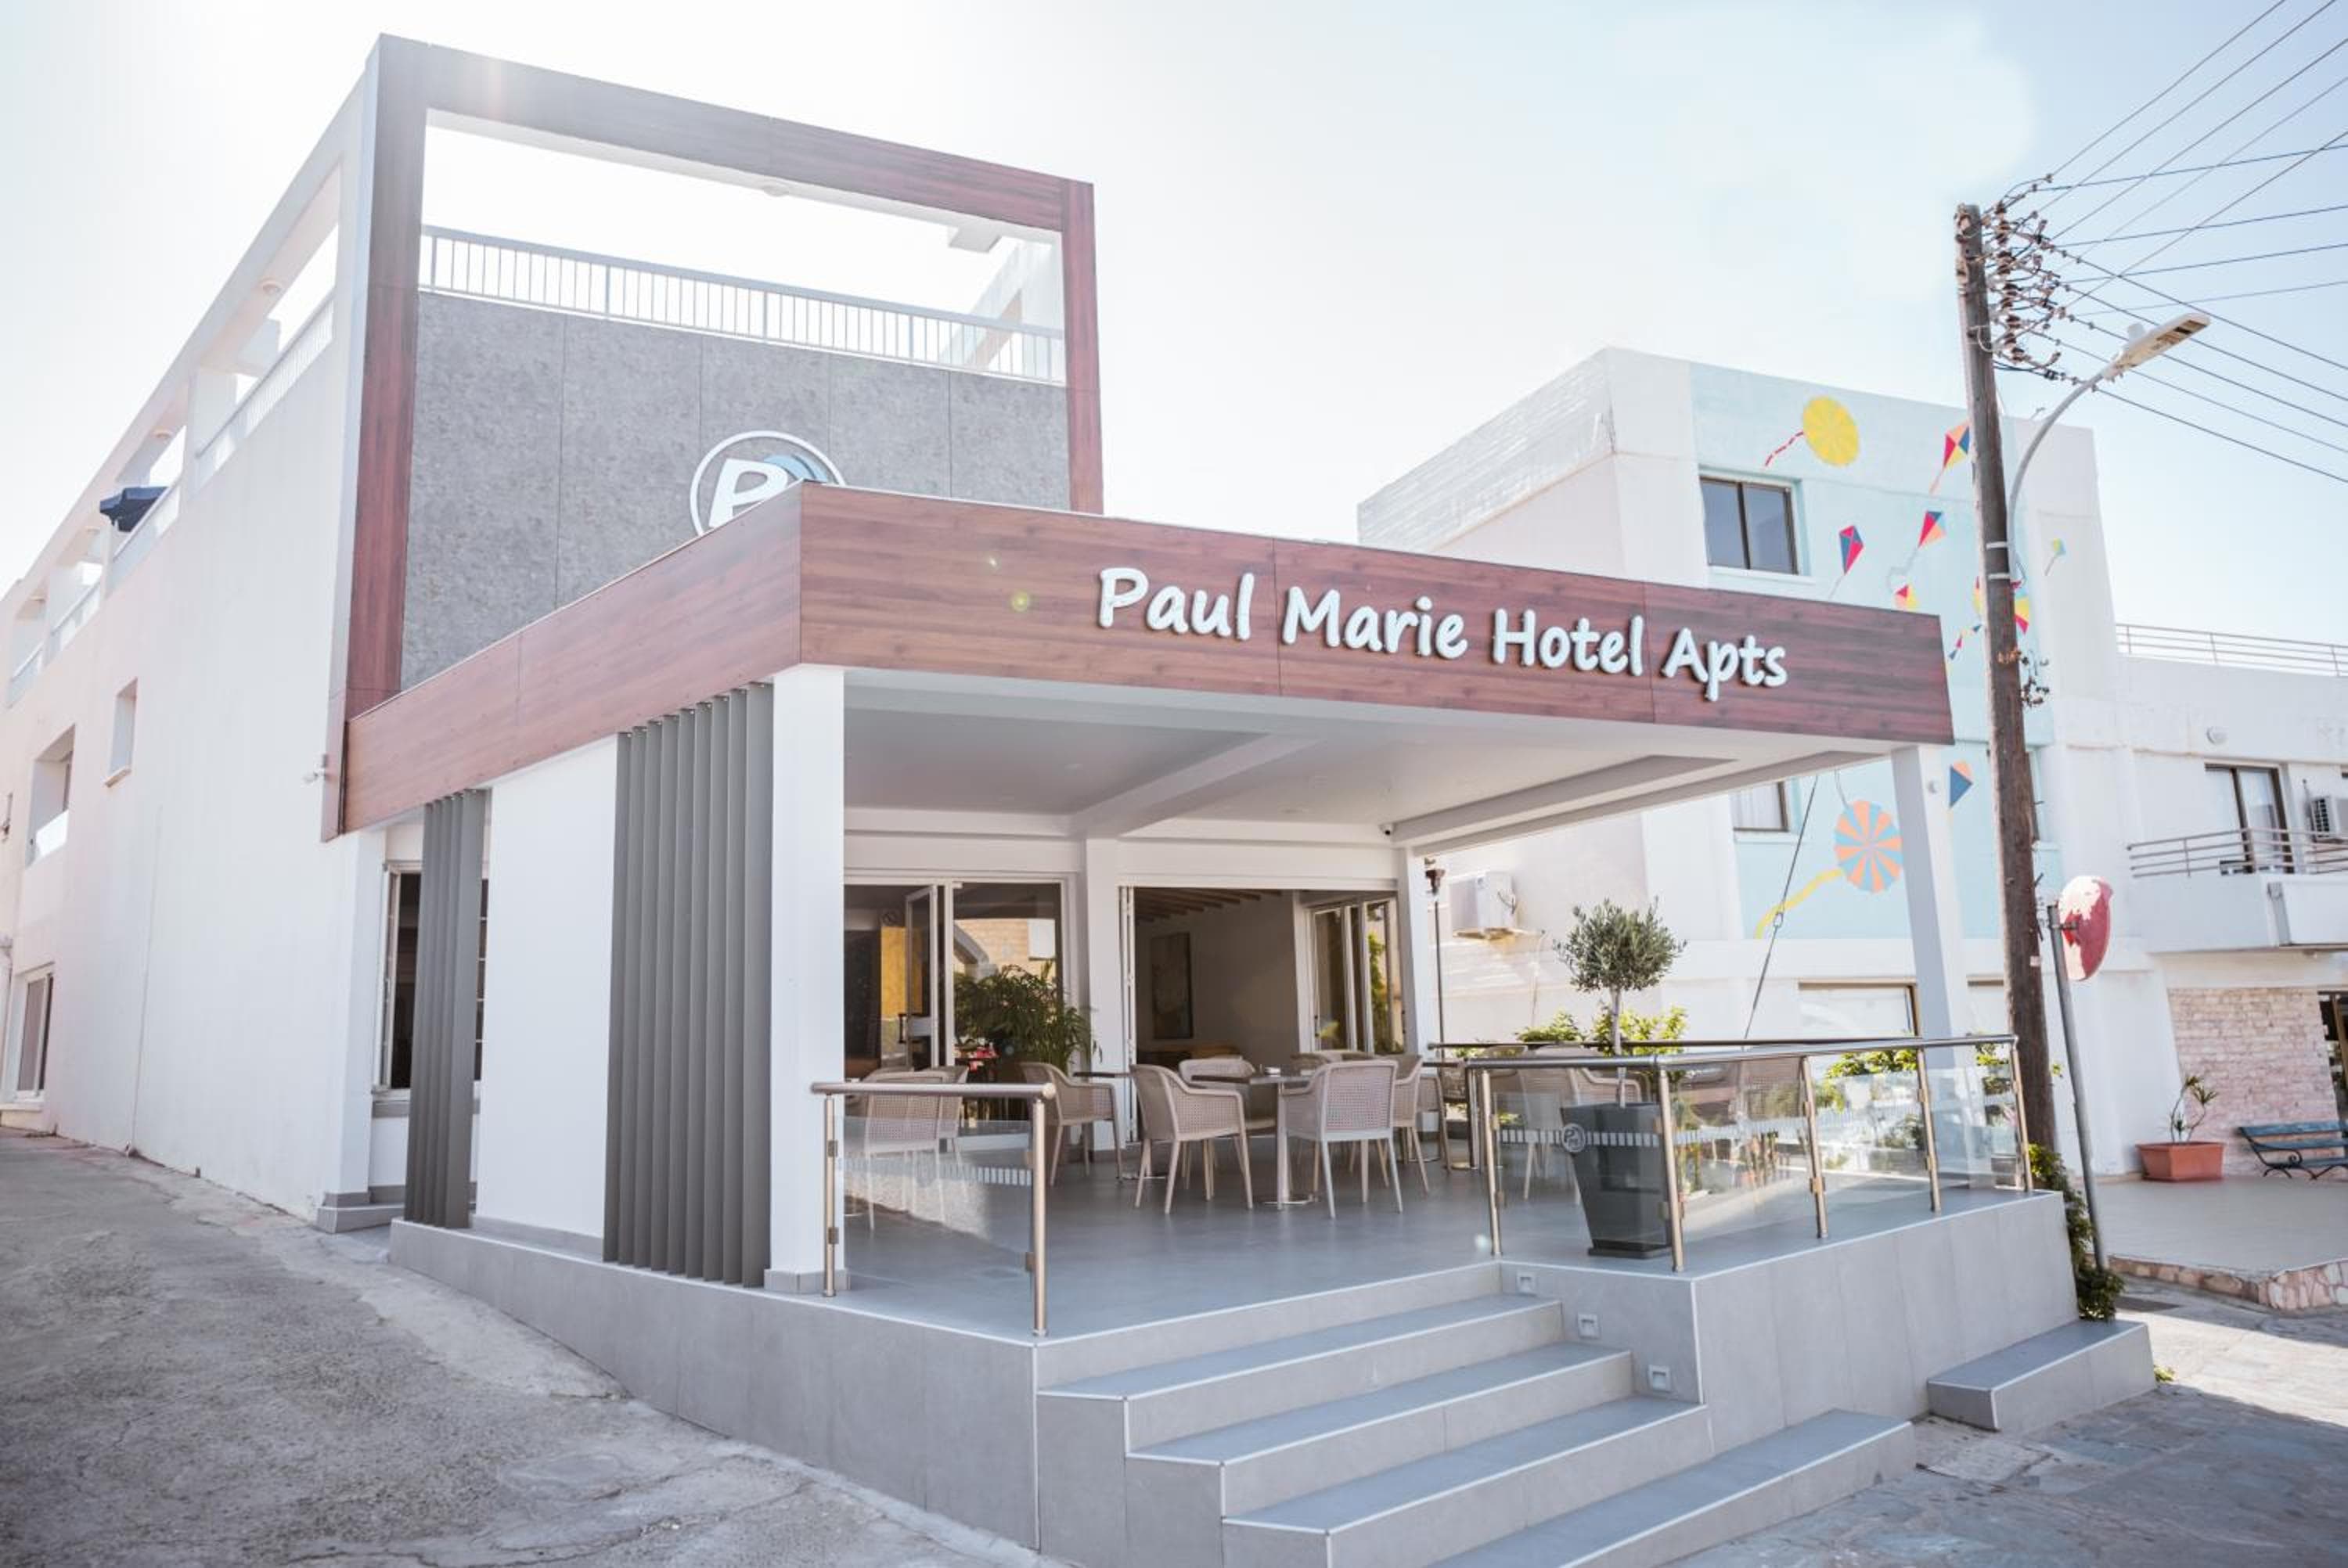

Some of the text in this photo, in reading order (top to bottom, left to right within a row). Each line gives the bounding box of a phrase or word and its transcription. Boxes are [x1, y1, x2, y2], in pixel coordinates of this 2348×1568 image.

[1100, 566, 1788, 702] Paul Marie Hotel Apts
